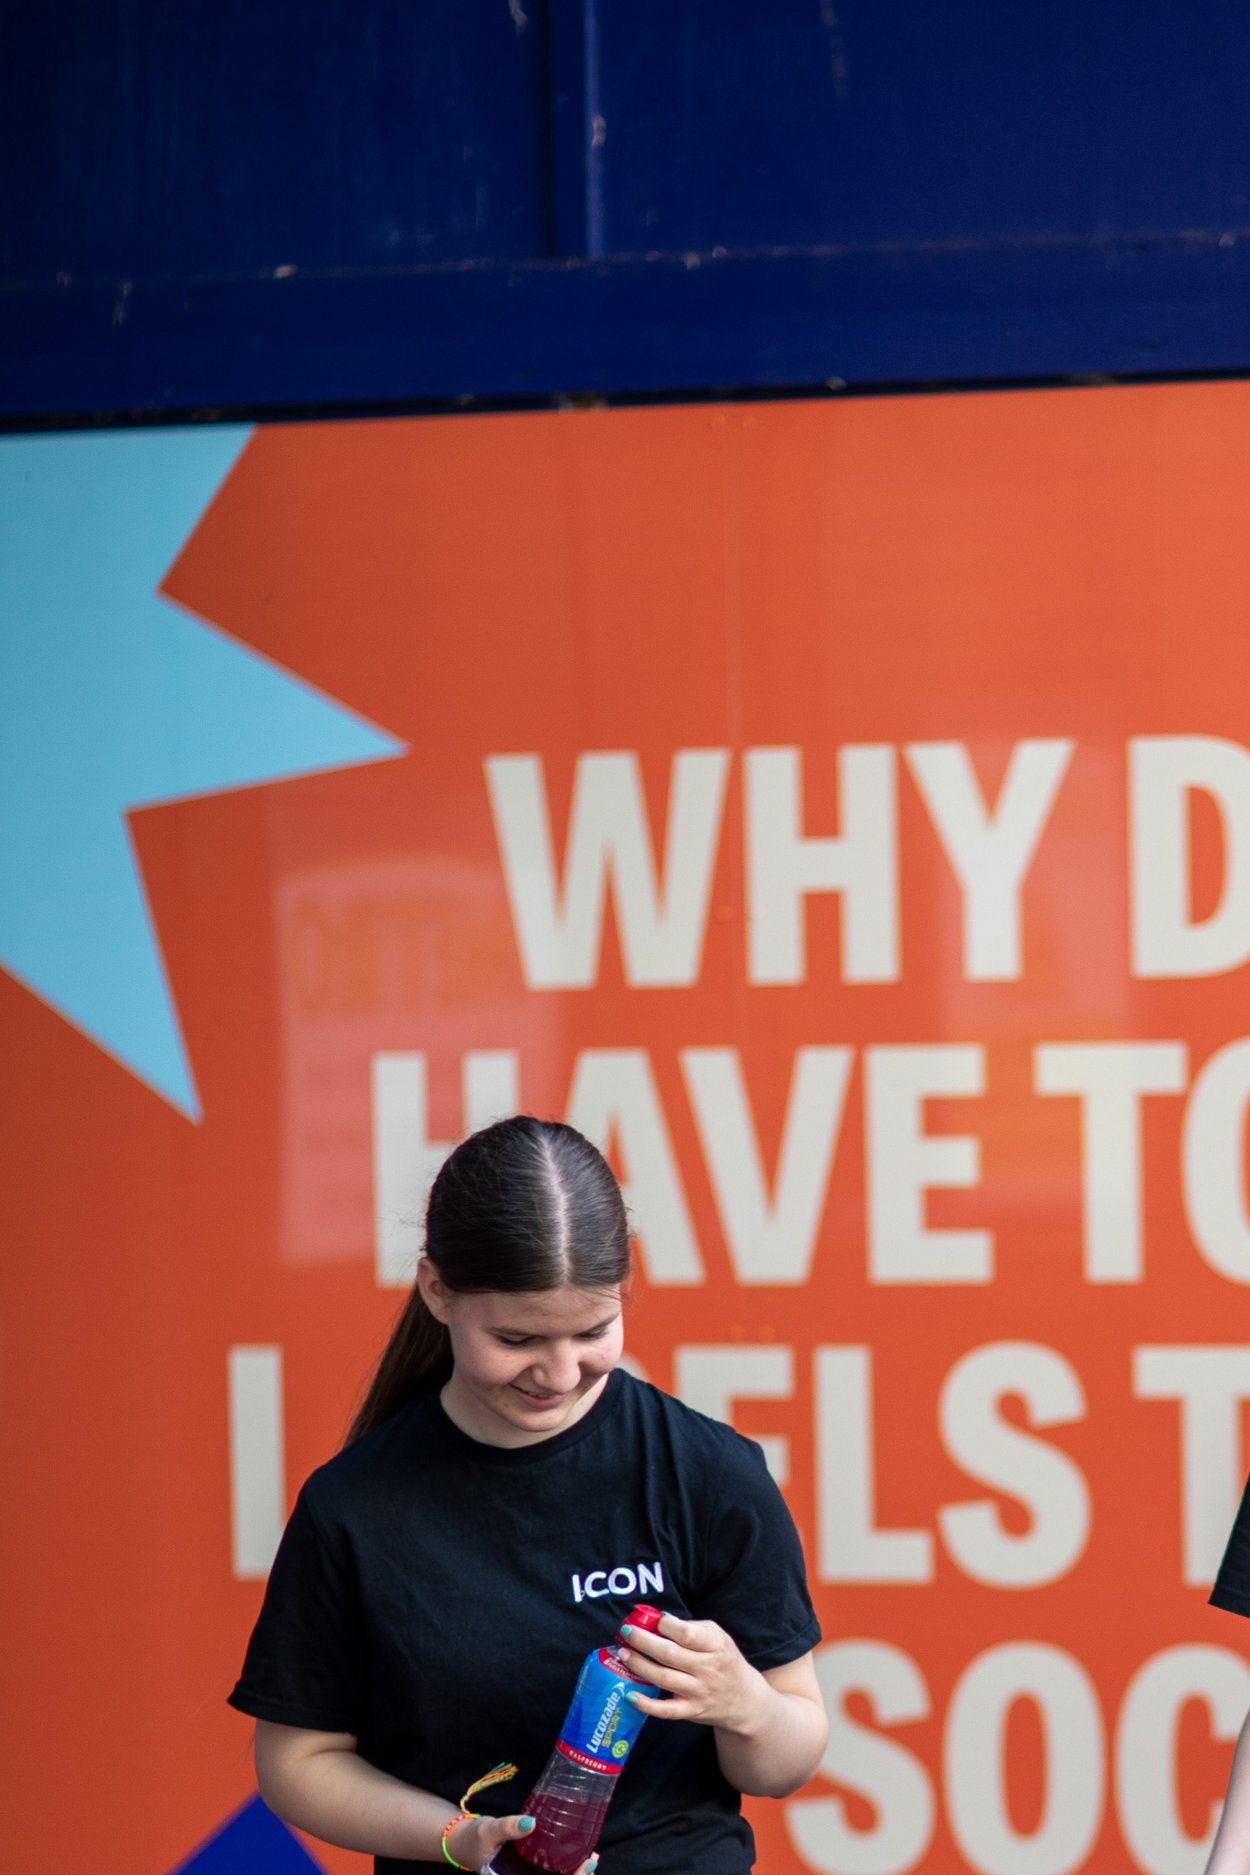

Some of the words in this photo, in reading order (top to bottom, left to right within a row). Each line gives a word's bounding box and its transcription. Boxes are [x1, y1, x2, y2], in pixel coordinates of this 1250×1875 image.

[484, 737, 1075, 991] WHY
[571, 1561, 664, 1603] ICON
[586, 1691, 621, 1754] Lucozade
